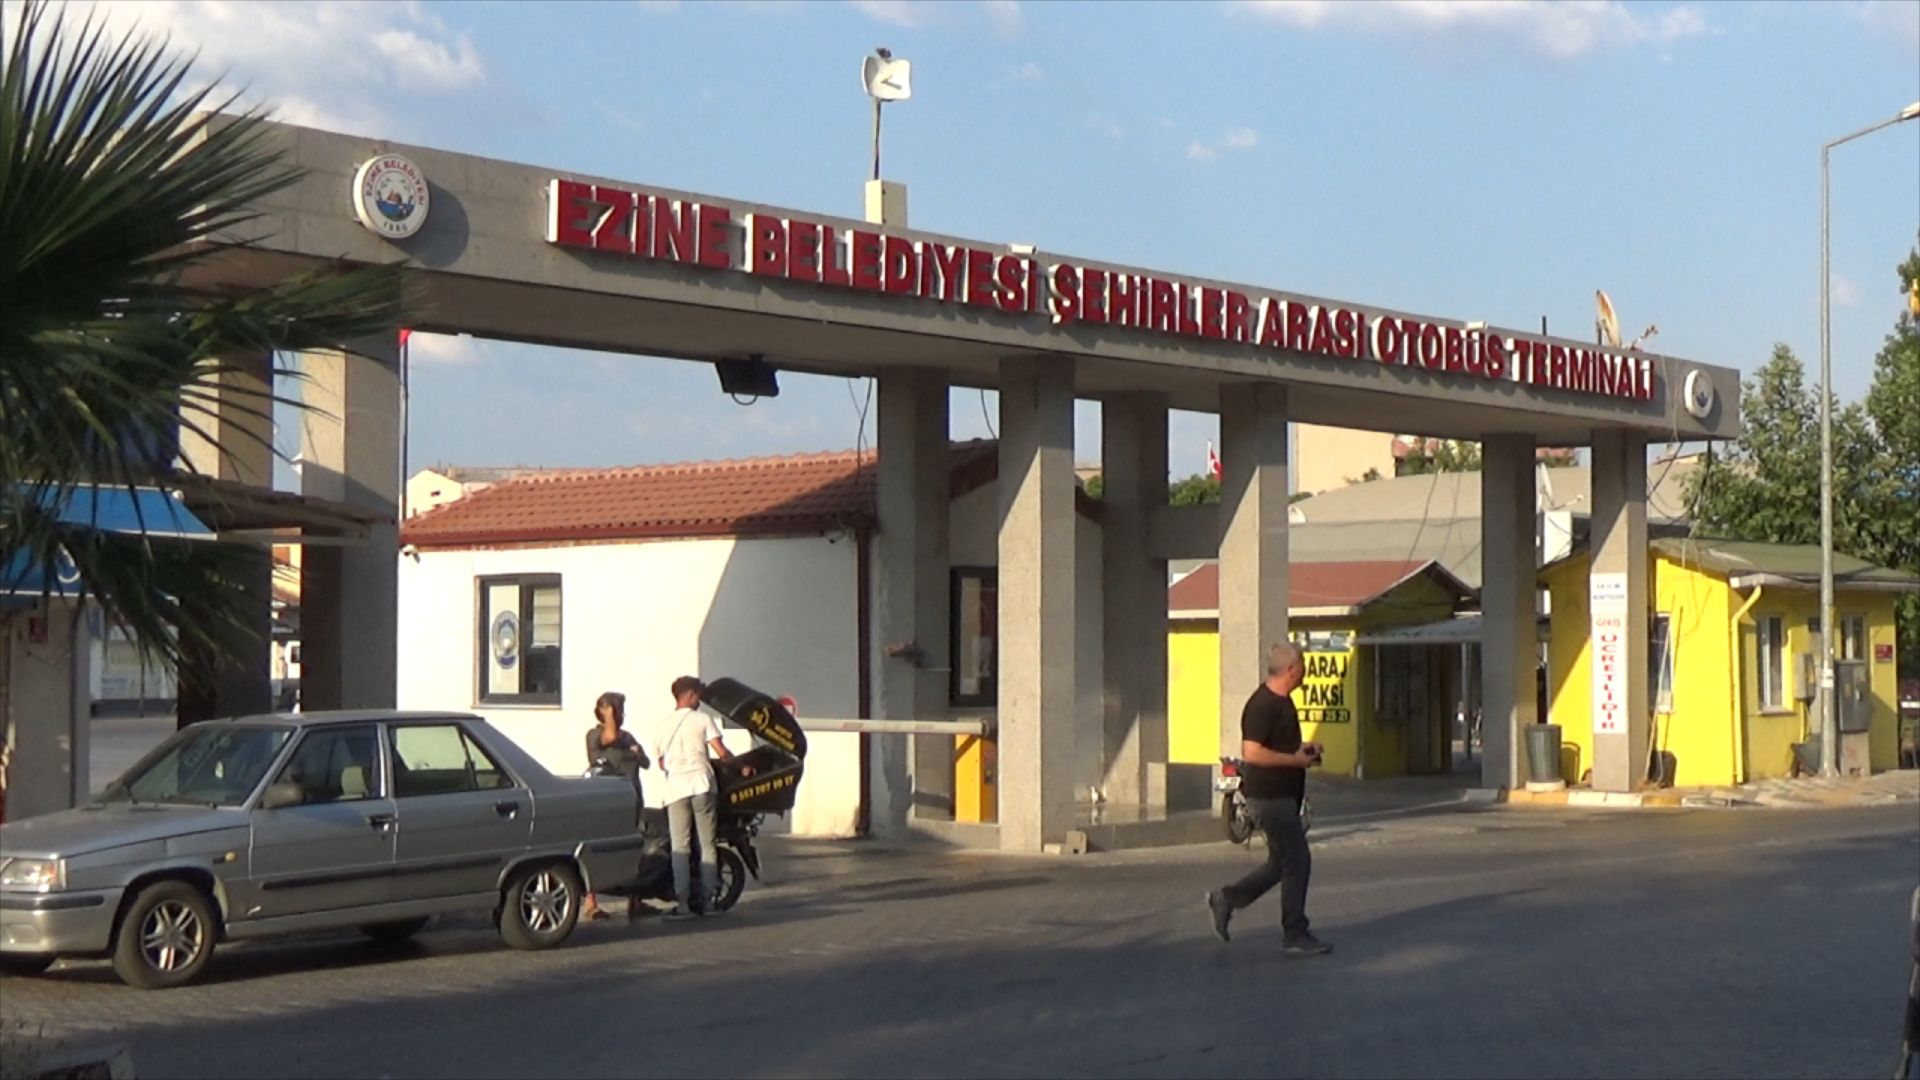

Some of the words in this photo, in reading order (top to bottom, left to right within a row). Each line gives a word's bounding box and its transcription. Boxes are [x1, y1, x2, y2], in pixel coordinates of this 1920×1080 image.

[549, 179, 730, 268] EZİNE
[744, 213, 1037, 313] BELEDİYESİ
[1048, 263, 1252, 343] ŞEHİRLER
[1255, 297, 1366, 358] ARASI
[1371, 315, 1506, 379] OTOBÜS
[1506, 338, 1655, 400] TERMİNALİ
[1302, 655, 1348, 678] ARAJ
[1301, 682, 1344, 706] TAKSİ
